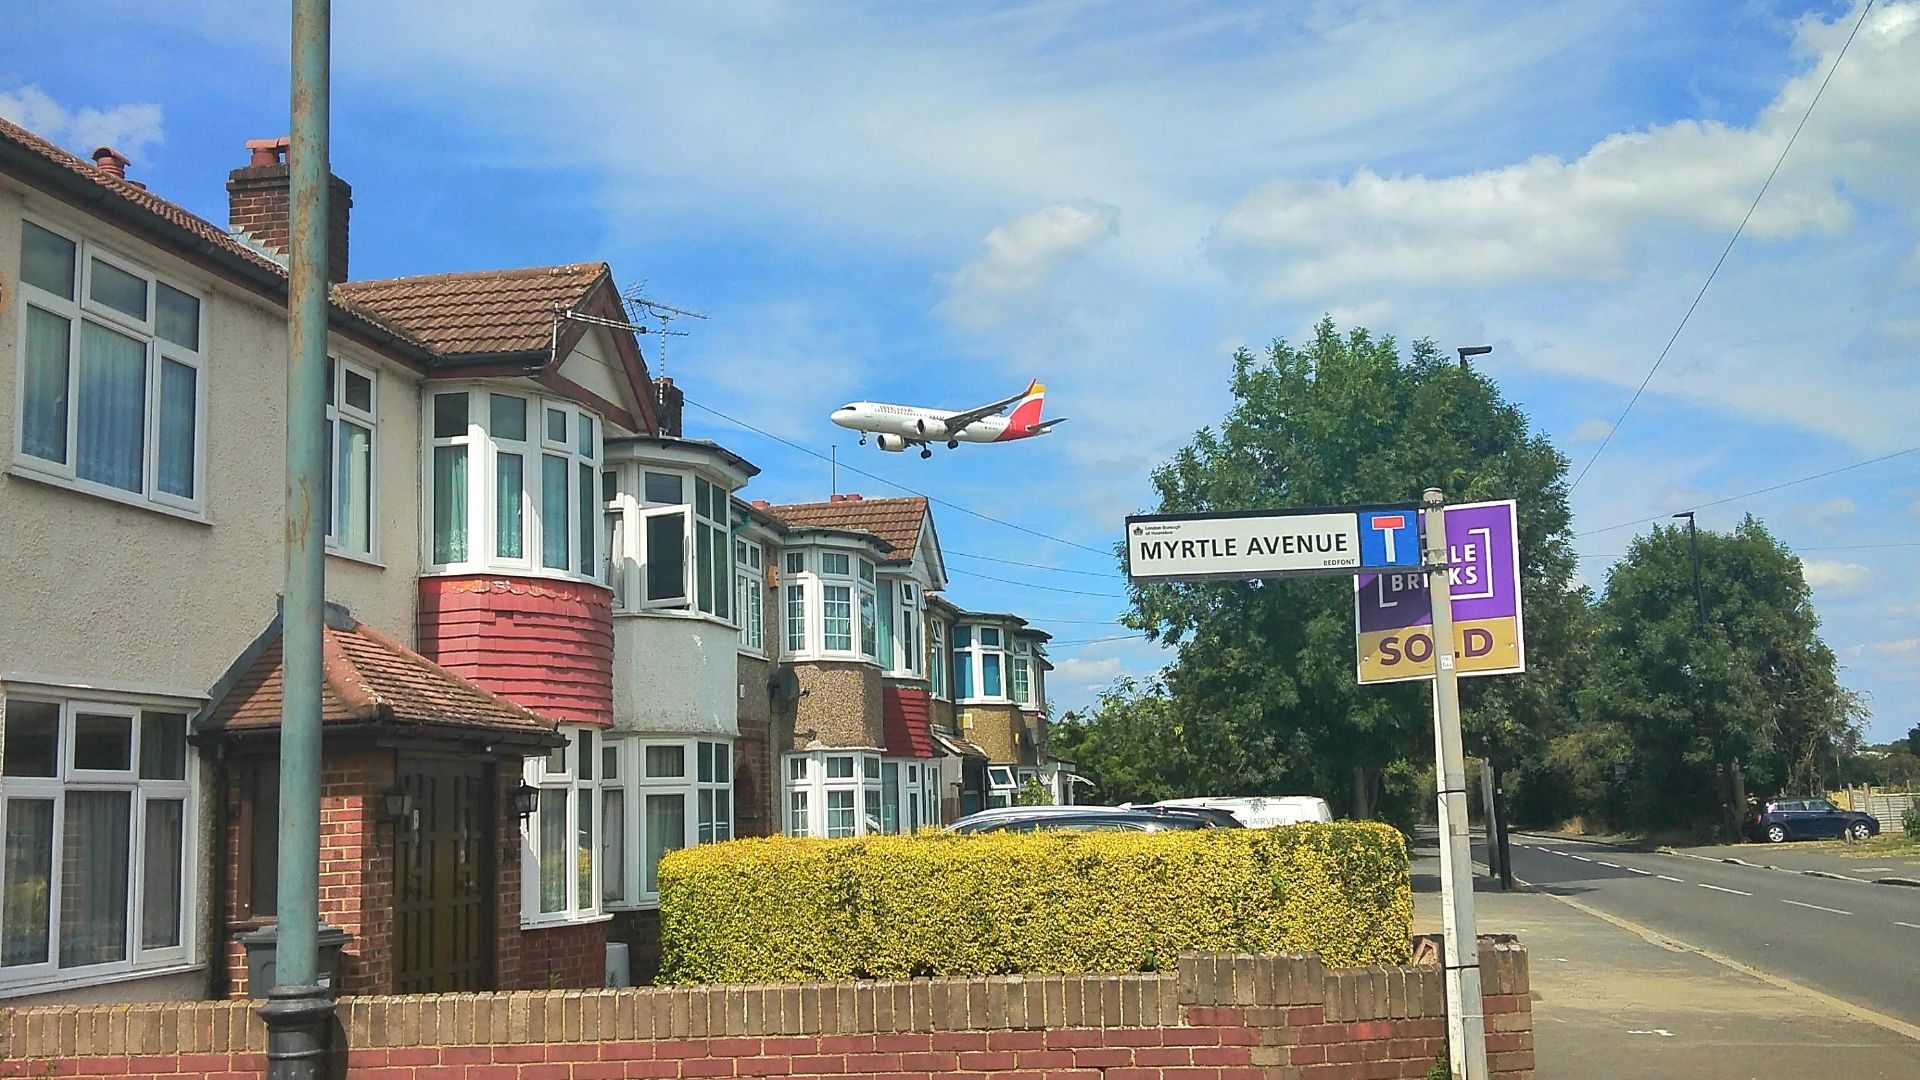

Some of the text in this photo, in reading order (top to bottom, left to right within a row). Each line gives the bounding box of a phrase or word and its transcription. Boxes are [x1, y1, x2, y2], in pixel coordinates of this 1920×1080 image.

[1140, 533, 1348, 560] MYRTLE AVENUE
[1391, 566, 1478, 592] BRIKS
[1379, 628, 1494, 666] SOD
